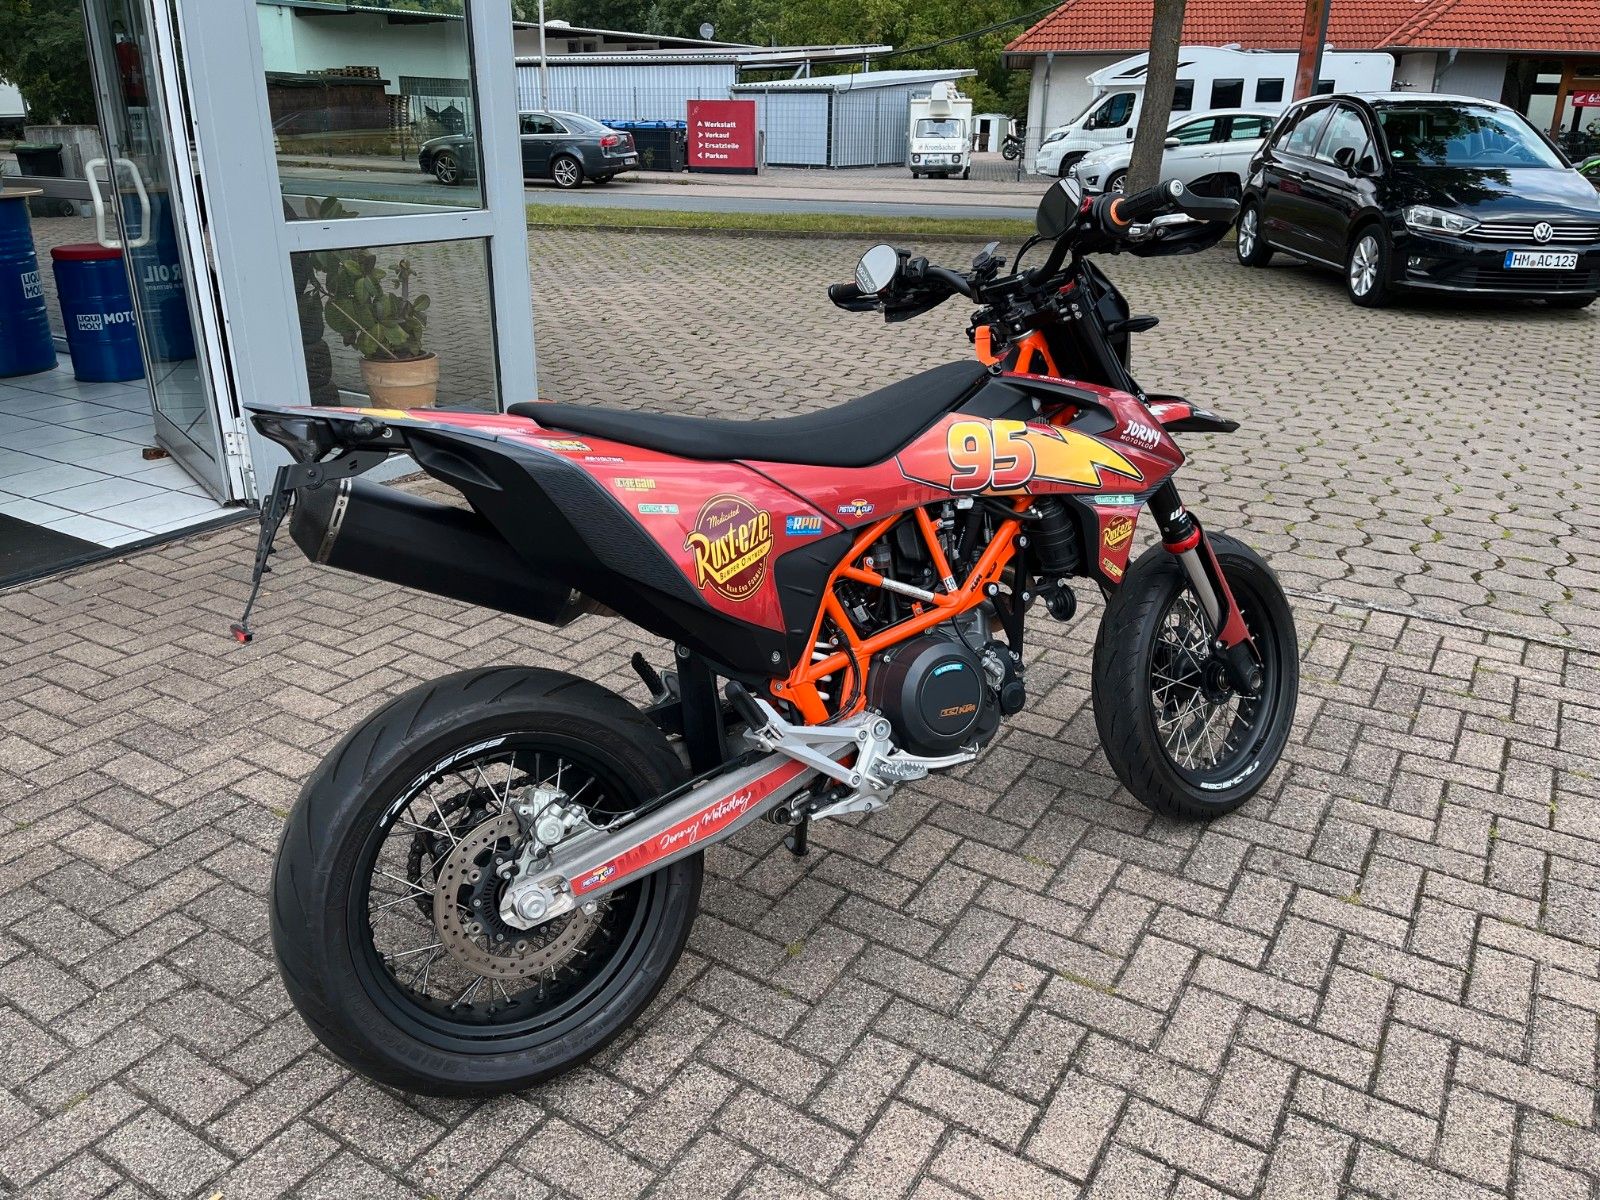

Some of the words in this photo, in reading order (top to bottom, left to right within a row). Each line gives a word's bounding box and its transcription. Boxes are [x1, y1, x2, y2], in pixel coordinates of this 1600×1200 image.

[1513, 254, 1531, 266] HM
[1537, 255, 1553, 267] AC
[1554, 256, 1577, 267] 123
[78, 315, 101, 323] LIQUI
[79, 322, 102, 330] MOLY
[1120, 435, 1154, 450] MOTOVLOG
[1123, 420, 1161, 447] JORNY
[947, 420, 1035, 491] 95
[706, 505, 740, 529] Medicated
[792, 517, 822, 530] RPM
[719, 563, 740, 580] BUMPER
[741, 545, 766, 566] OINTMENT
[726, 584, 738, 593] REAR
[738, 584, 748, 593] END
[748, 562, 763, 587] FORMULA
[701, 791, 751, 826] Motovlog
[582, 875, 599, 887] PISTON
[603, 867, 614, 877] CUP
